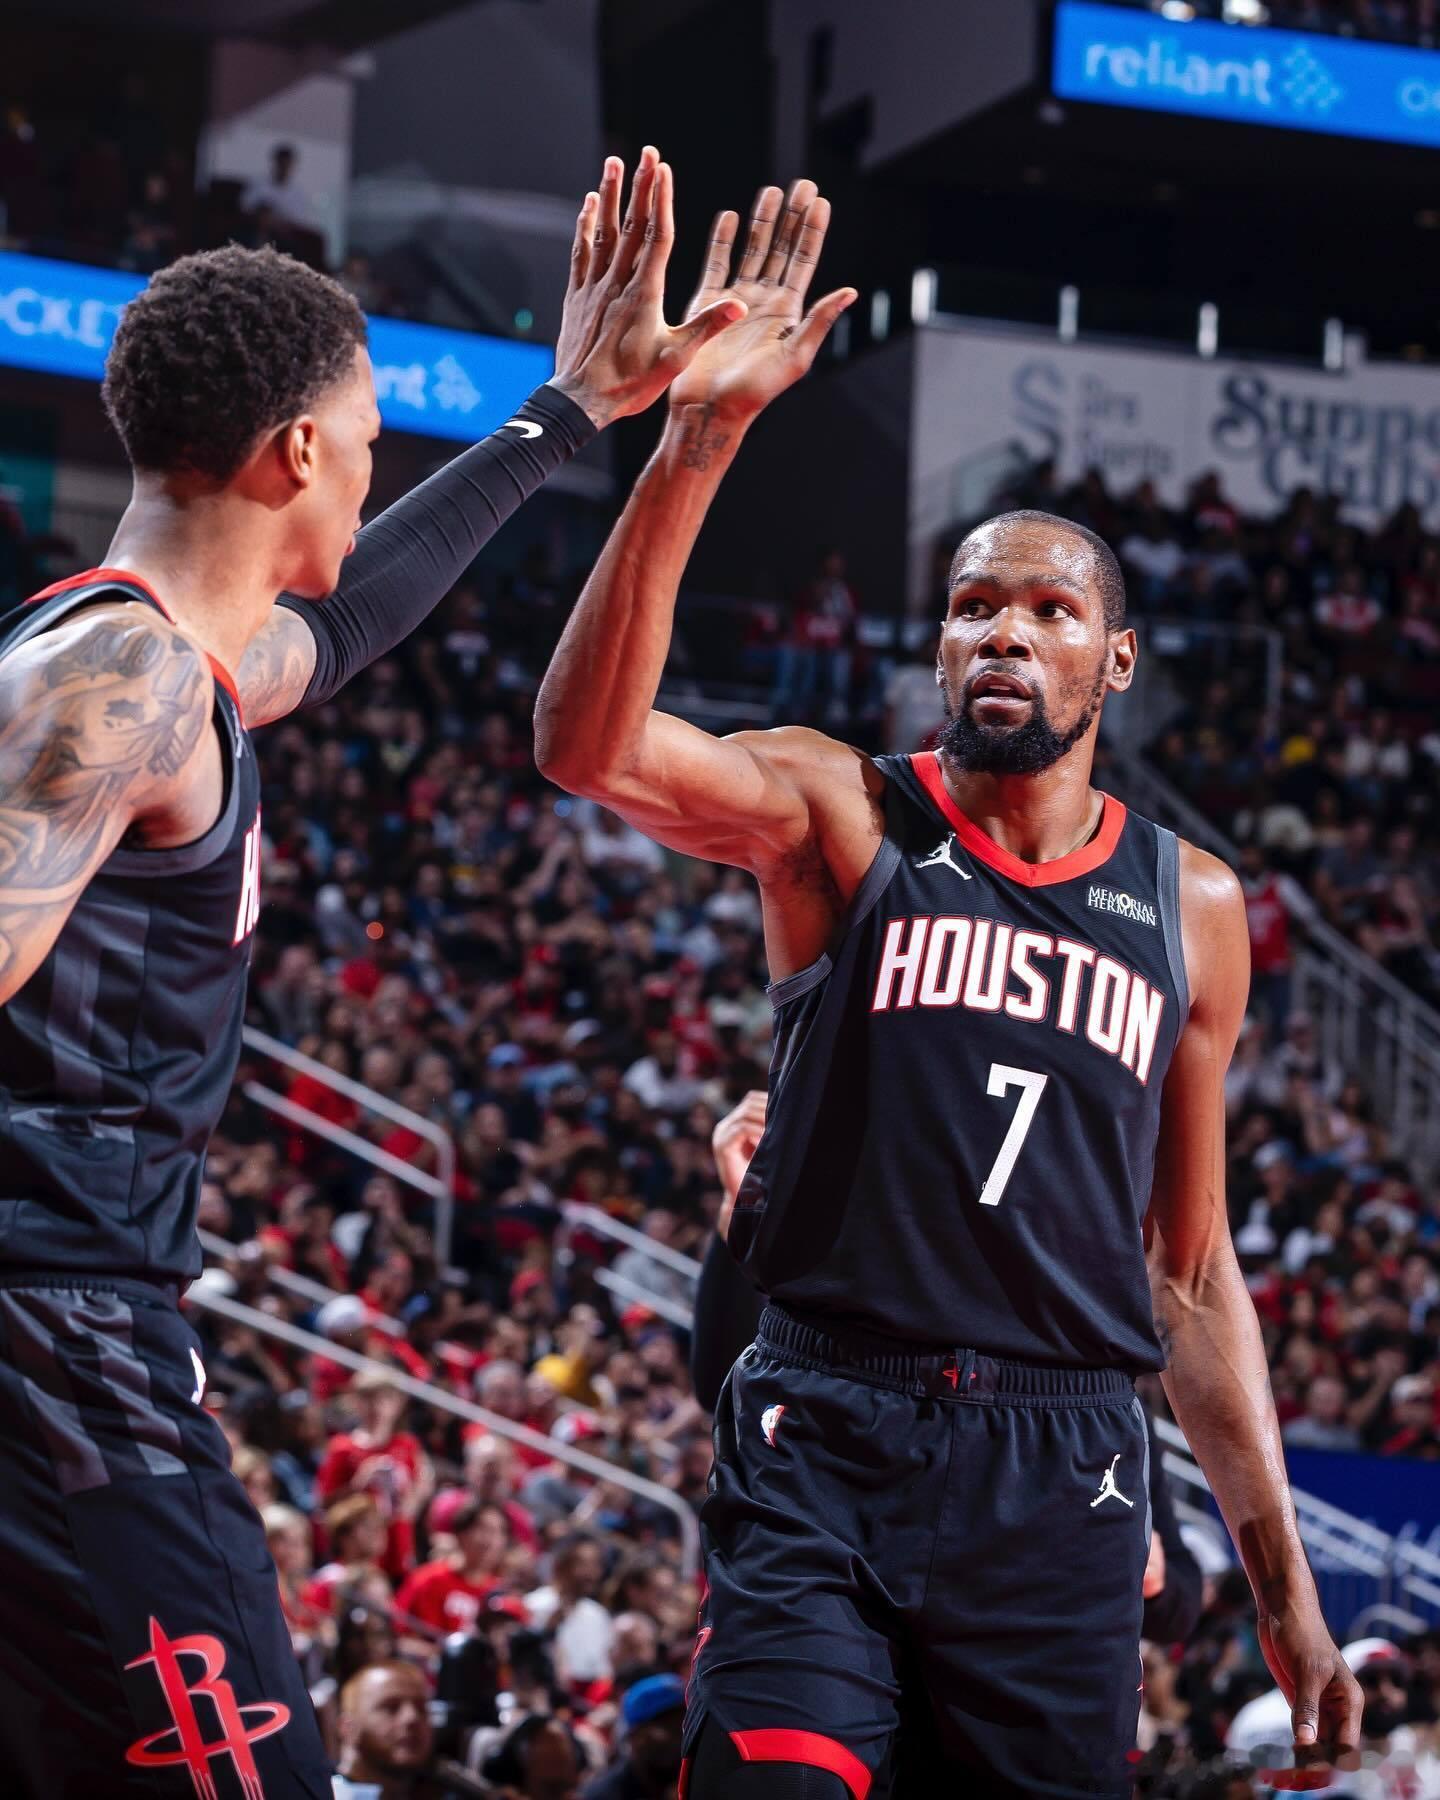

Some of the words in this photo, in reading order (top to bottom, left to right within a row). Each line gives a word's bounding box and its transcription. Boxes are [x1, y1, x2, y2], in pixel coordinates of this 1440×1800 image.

[1085, 40, 1271, 105] reliant
[1088, 886, 1156, 919] MEMORIAL
[1088, 896, 1156, 926] HERMANN
[871, 913, 1166, 1087] HOUSTON
[978, 1063, 1048, 1206] 7
